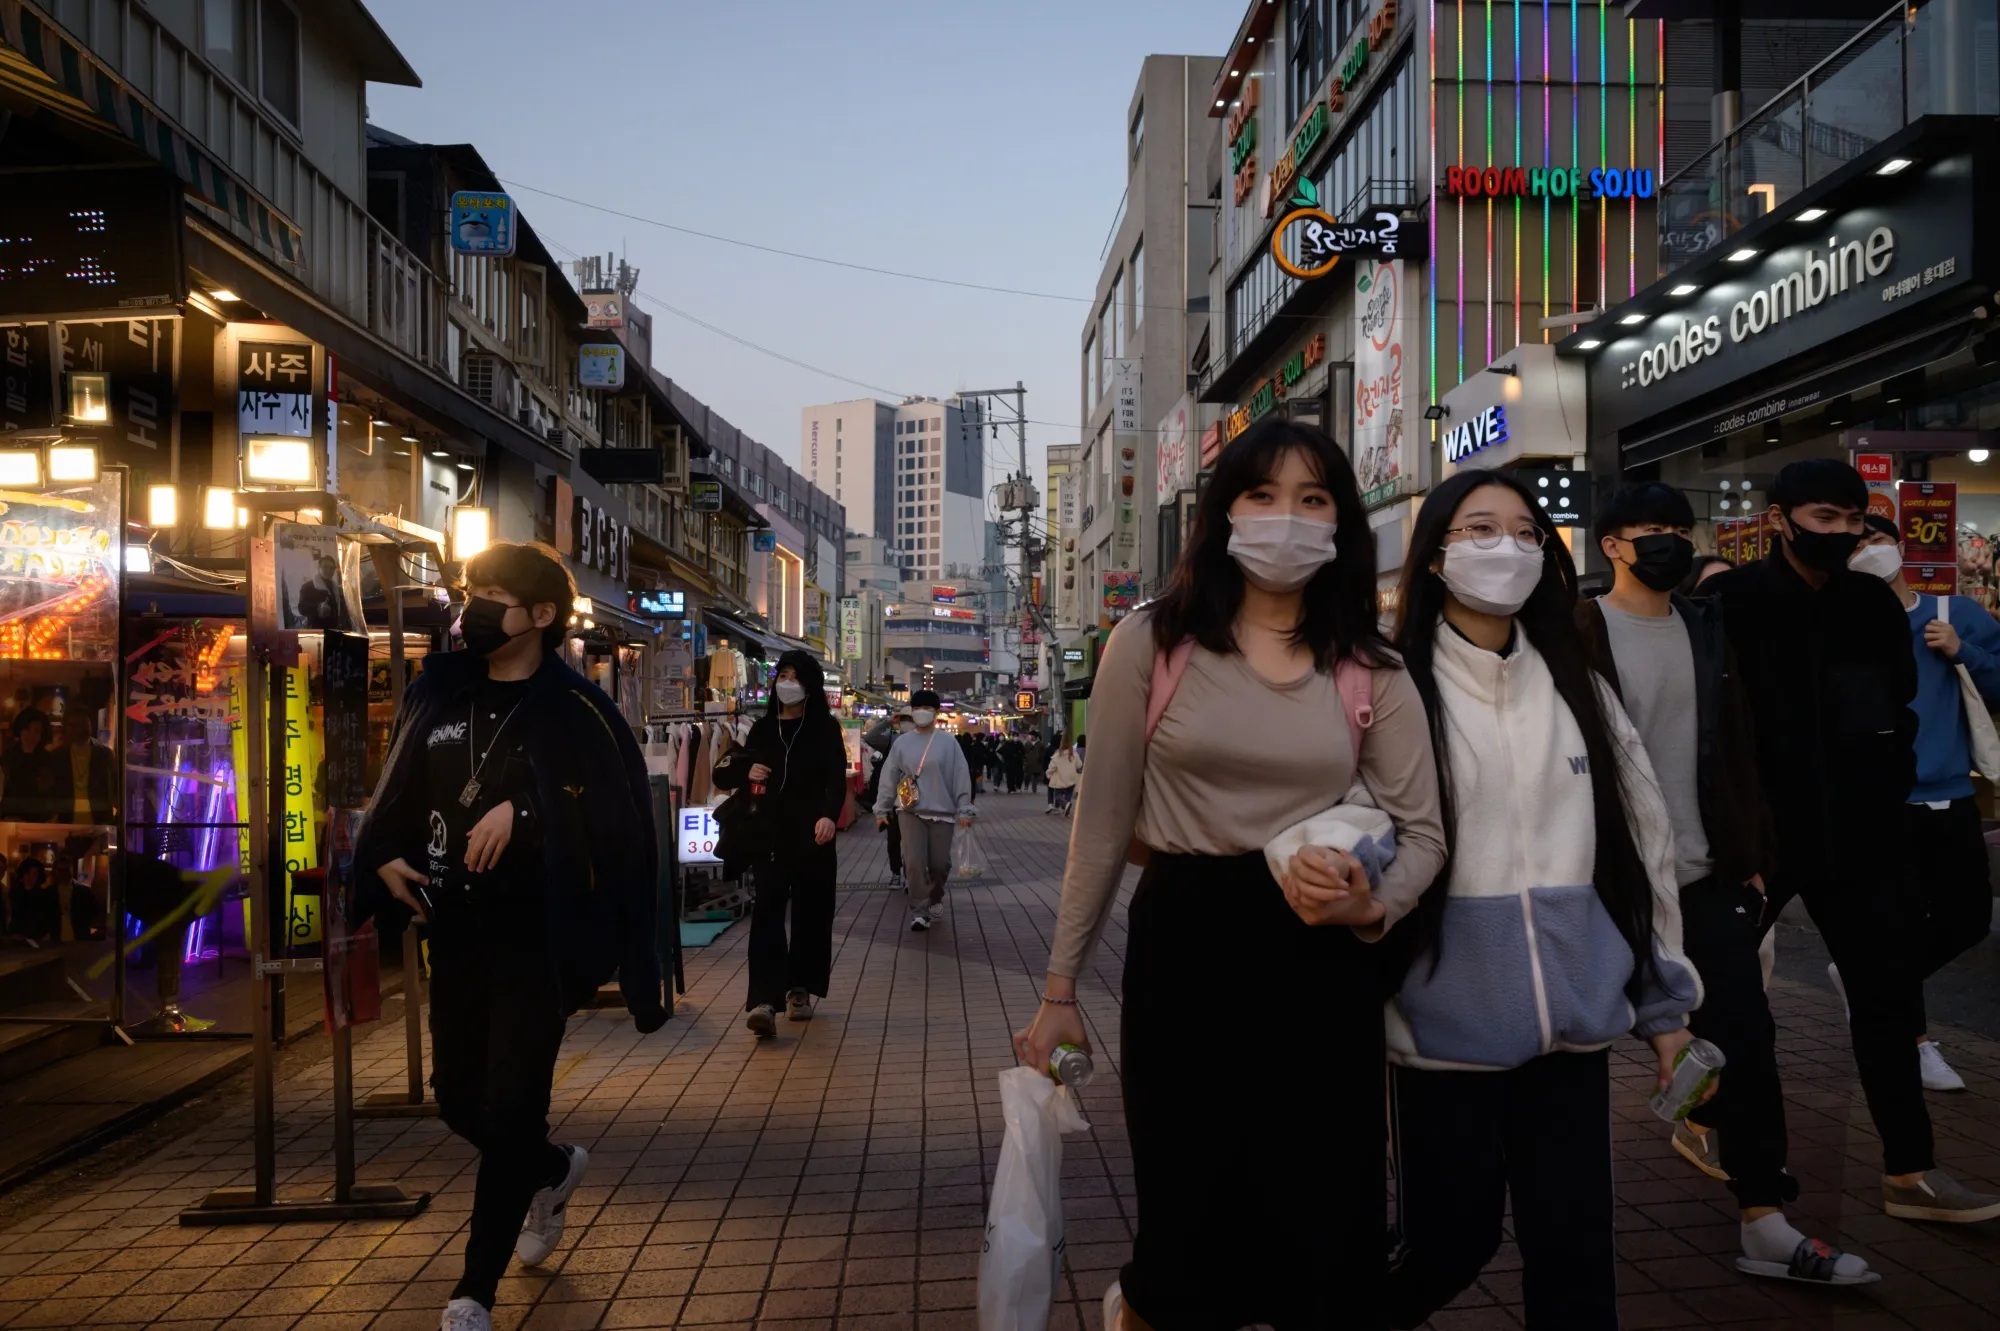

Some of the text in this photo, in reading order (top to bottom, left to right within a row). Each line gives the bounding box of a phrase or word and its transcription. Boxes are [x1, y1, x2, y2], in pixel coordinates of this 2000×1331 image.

[1340, 37, 1368, 92] SOJU
[1369, 0, 1398, 52] HOF
[1448, 166, 1653, 198] ROOM HOF SOJU
[1306, 212, 1399, 254] 오렌지룸
[1882, 256, 1955, 302] 이너웨어 홍대점
[1638, 227, 1894, 387] codes combine
[244, 352, 308, 383] 사주
[1284, 352, 1304, 389] SOJU
[1304, 333, 1326, 372] HOF
[1357, 343, 1402, 426] 오렌지룸
[1442, 405, 1501, 463] WAVE
[1719, 413, 1746, 434] codes
[1747, 398, 1786, 423] combine
[1552, 512, 1579, 520] combine
[684, 813, 720, 836] 타
[687, 840, 713, 854] 3.0
[291, 904, 314, 938] 상
